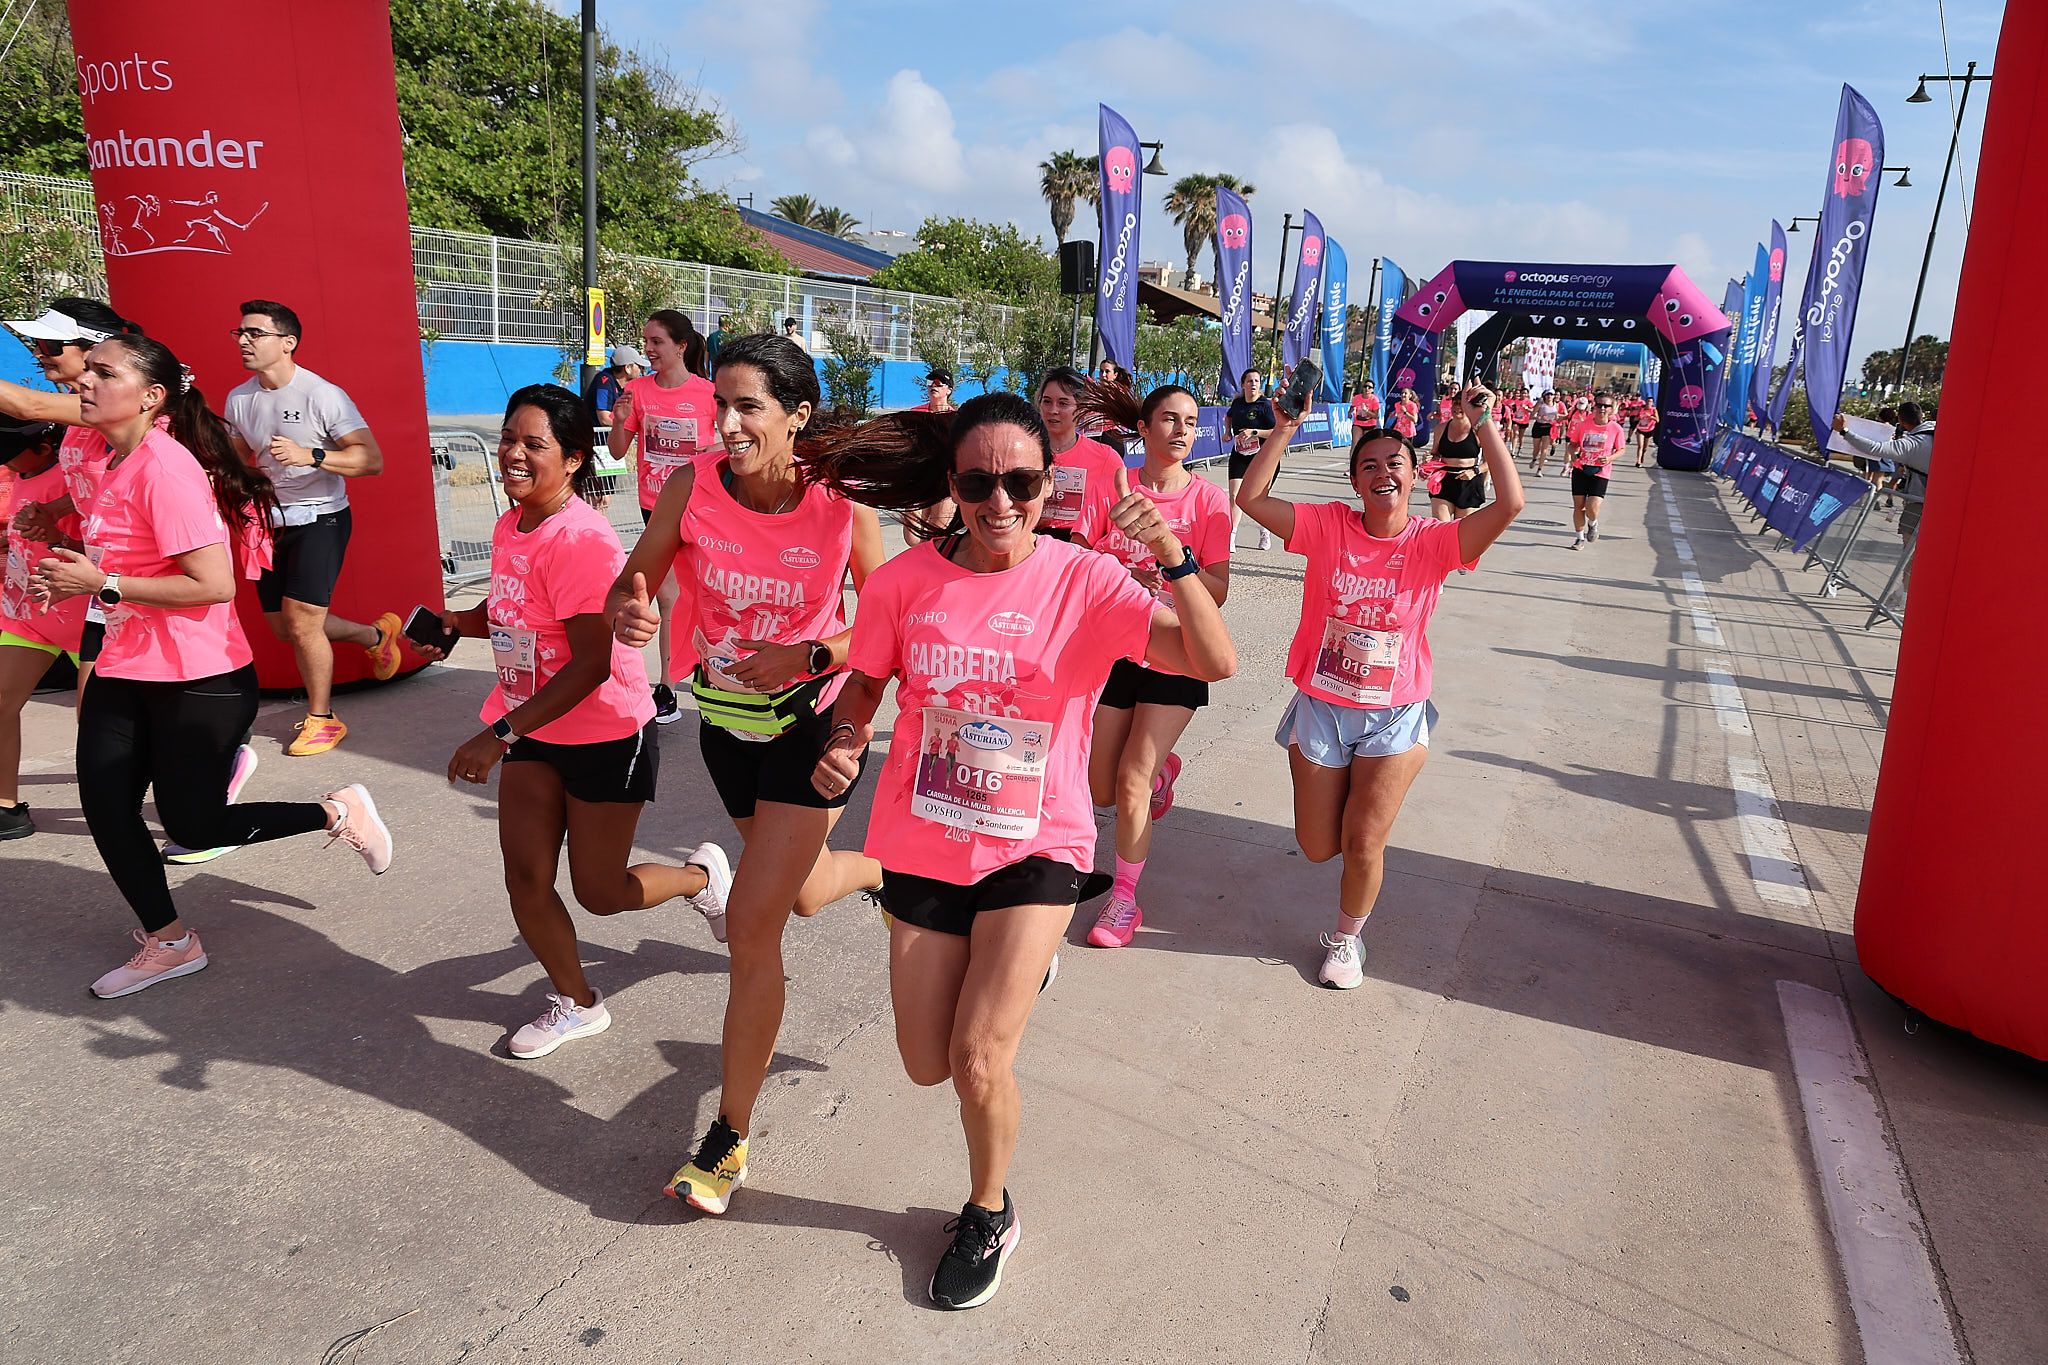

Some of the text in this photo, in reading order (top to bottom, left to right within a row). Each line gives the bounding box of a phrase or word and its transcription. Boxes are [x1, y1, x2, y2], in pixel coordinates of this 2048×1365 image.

[77, 53, 173, 104] Sports
[86, 129, 264, 170] Santander
[1508, 287, 1546, 297] ENERGÍA
[1549, 290, 1574, 298] PARA
[1576, 291, 1614, 300] CORRER
[1516, 299, 1566, 307] VELOCIDAD
[1582, 300, 1593, 308] LA
[1530, 314, 1636, 329] VOLVO
[660, 438, 680, 449] 016
[698, 535, 743, 555] OYSHO
[1342, 657, 1370, 677] 016
[1321, 680, 1343, 692] OYSHO
[935, 715, 957, 727] SUMA
[962, 727, 1008, 746] ASTURIANA
[956, 764, 1003, 791] 016
[926, 789, 1026, 817] CARRERA DE LA MUJER VALENCIA
[966, 789, 988, 802] 1265
[925, 802, 962, 820] OYSHO
[985, 819, 1024, 832] Santander
